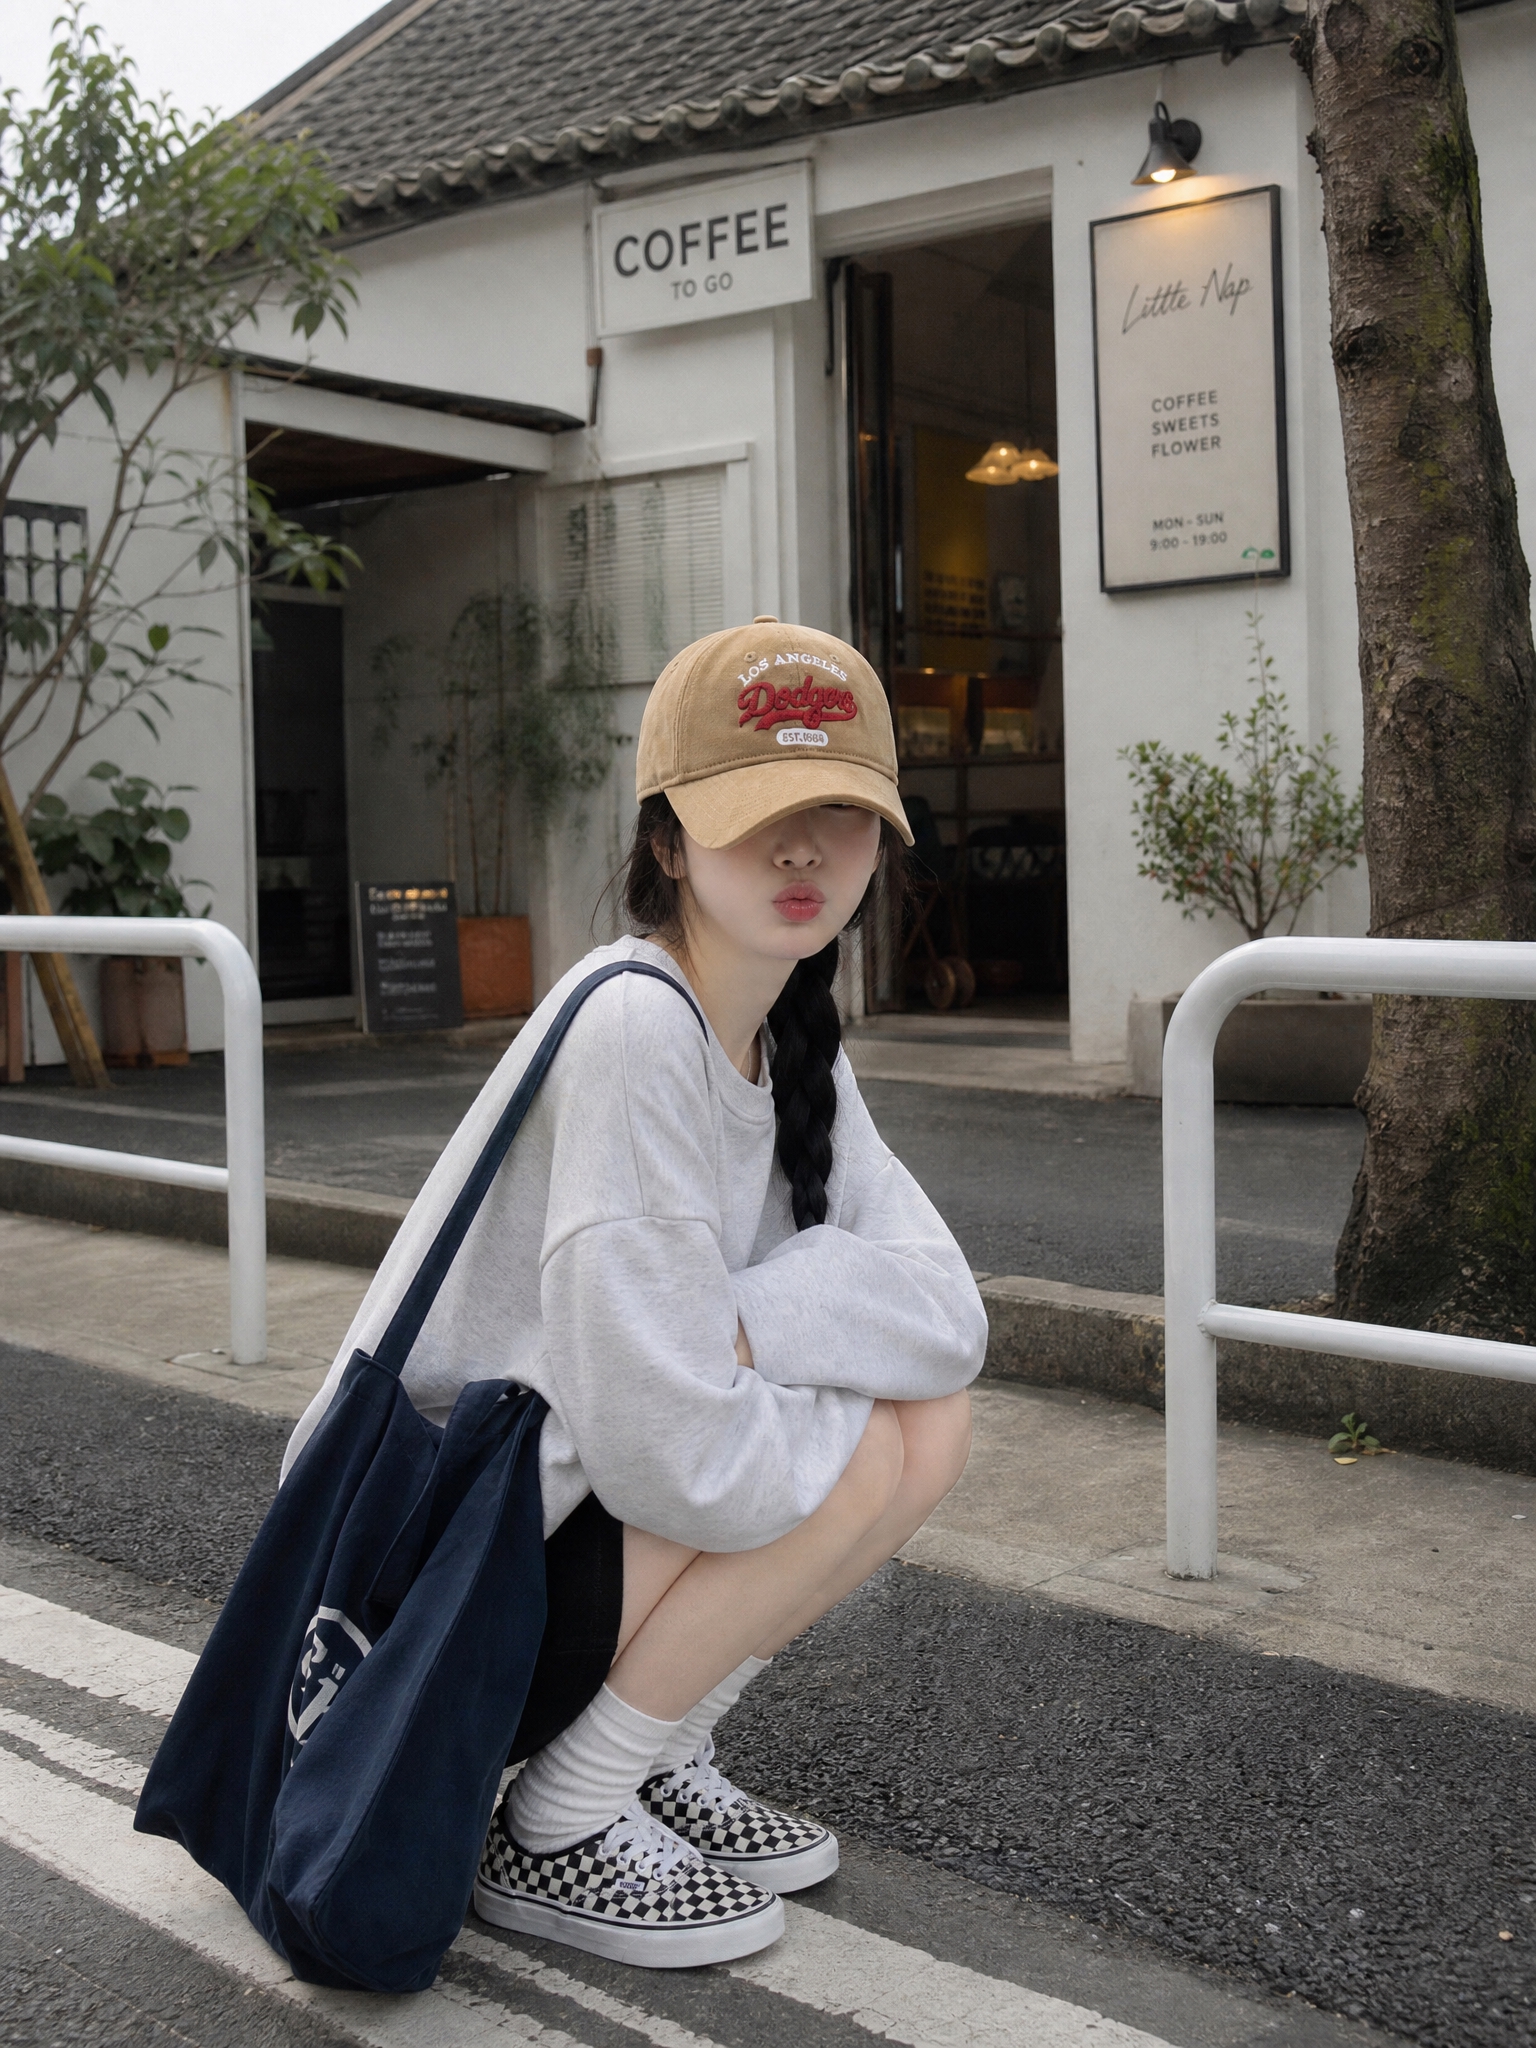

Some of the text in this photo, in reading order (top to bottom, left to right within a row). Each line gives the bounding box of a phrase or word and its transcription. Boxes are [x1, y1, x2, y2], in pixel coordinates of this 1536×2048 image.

[614, 203, 789, 277] COFFEE
[671, 272, 733, 300] TO GO
[1122, 261, 1254, 335] Little Nap
[1151, 389, 1218, 413] COFFEE
[1151, 412, 1219, 436] SWEETS
[1151, 435, 1222, 459] FLOWER
[1152, 516, 1184, 532] MON
[1196, 510, 1224, 527] SUN
[1150, 536, 1180, 551] 9:00
[1193, 530, 1228, 546] 19:00
[737, 652, 848, 687] LOS ANGELES
